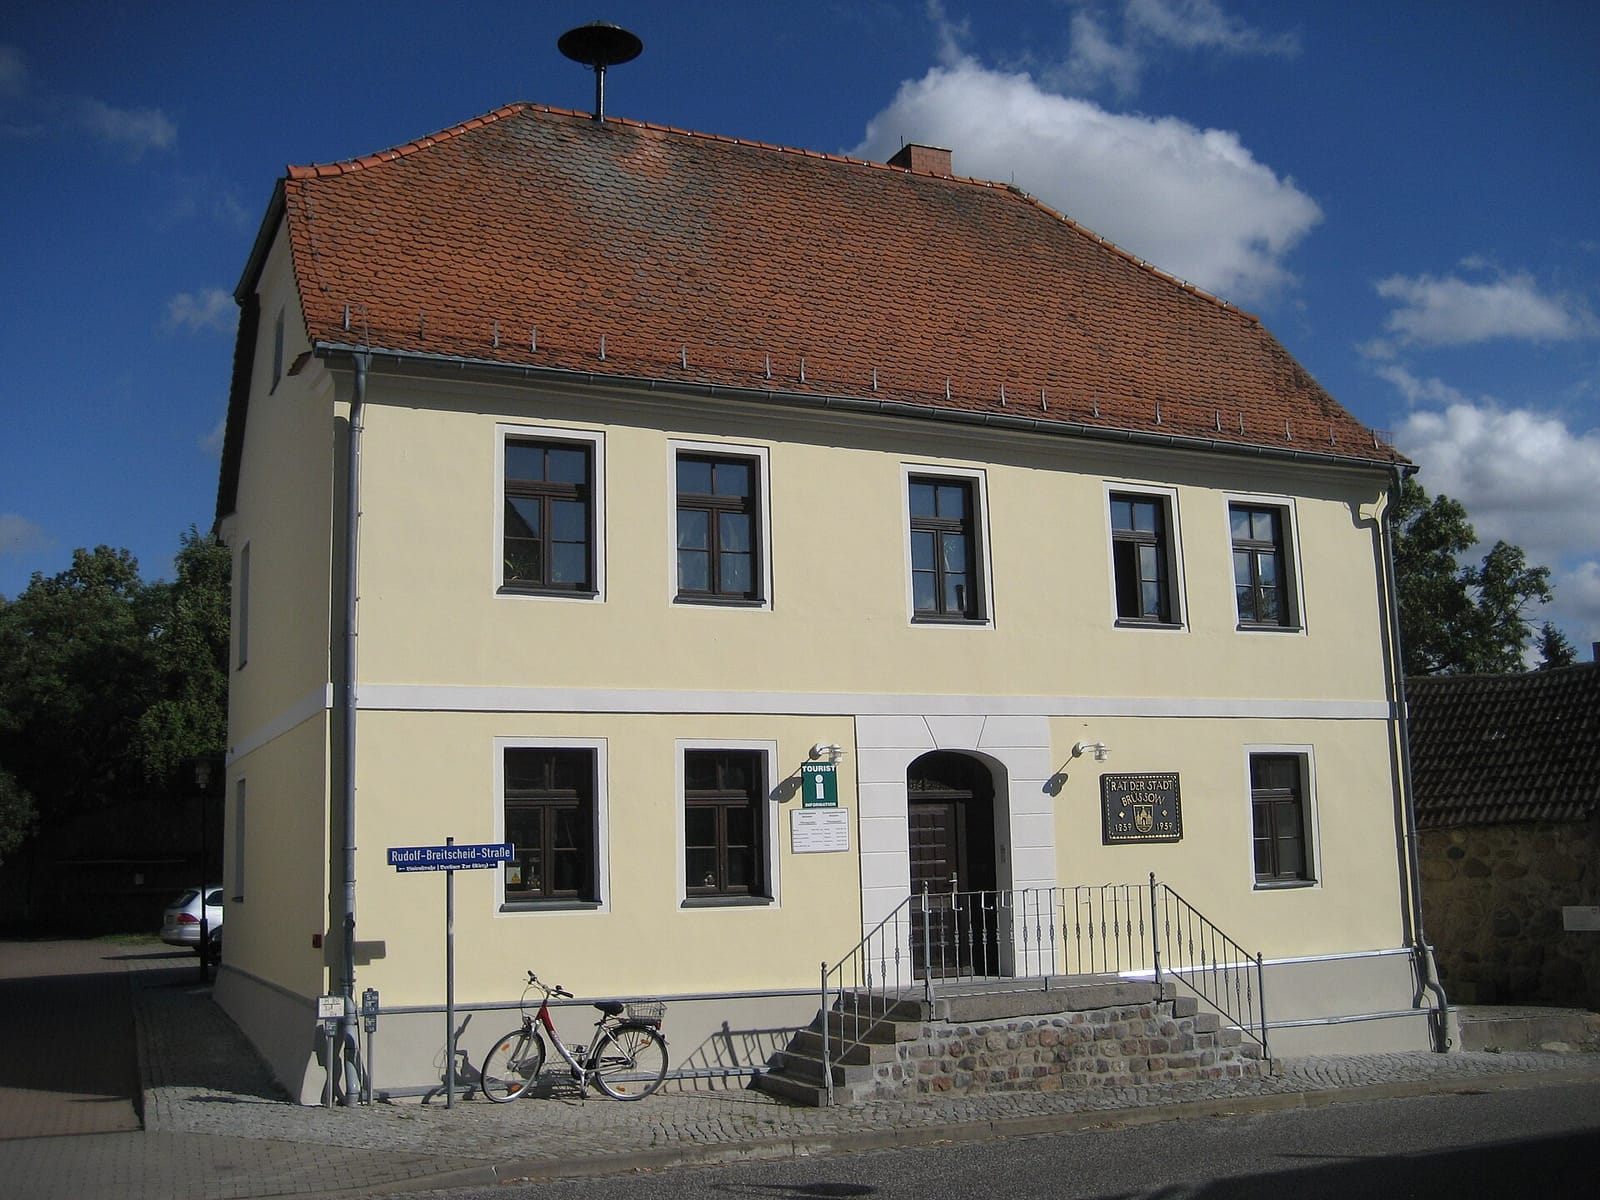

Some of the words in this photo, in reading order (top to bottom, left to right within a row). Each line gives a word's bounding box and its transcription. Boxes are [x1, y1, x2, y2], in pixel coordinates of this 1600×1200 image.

[1111, 781, 1128, 791] RAT
[1130, 781, 1145, 791] DER
[1147, 780, 1173, 790] STADT
[1121, 792, 1166, 806] BRÜSSOW
[1115, 823, 1132, 832] 1259
[1157, 822, 1173, 832] 1959
[391, 847, 511, 861] Rudolf-Breitscheid-Straße
